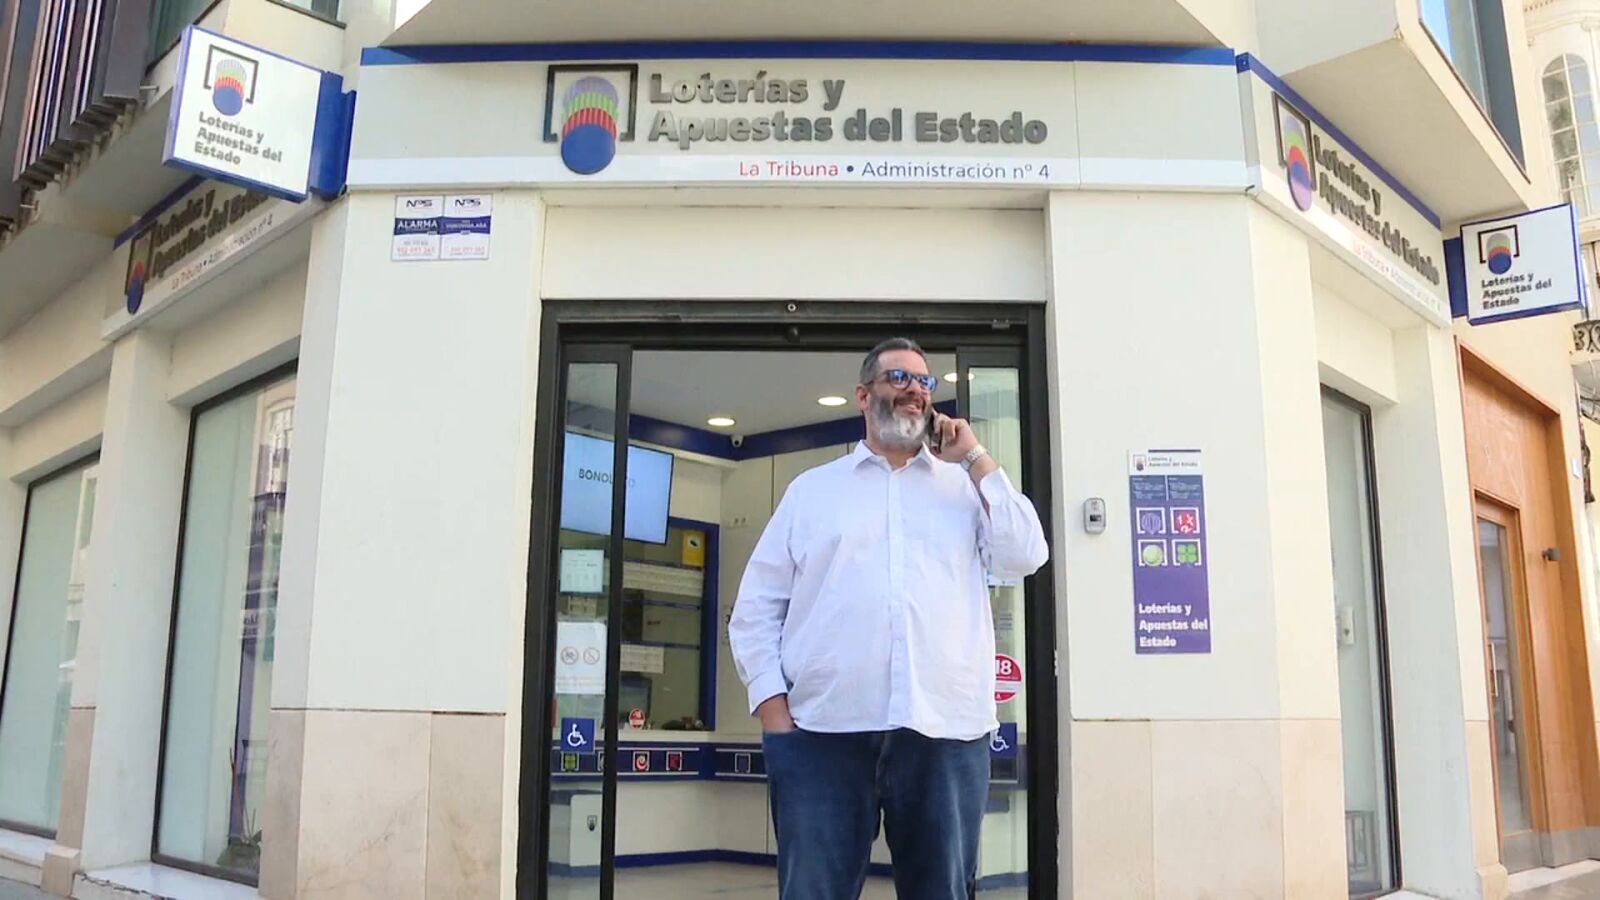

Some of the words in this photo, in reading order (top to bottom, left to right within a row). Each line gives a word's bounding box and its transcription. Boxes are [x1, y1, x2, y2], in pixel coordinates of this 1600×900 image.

[650, 70, 810, 104] Loterías
[822, 79, 845, 111] y
[256, 131, 265, 144] y
[648, 110, 833, 151] Apuestas
[843, 107, 902, 142] del
[915, 110, 1048, 145] Estado
[194, 140, 241, 165] Estado
[197, 127, 260, 156] Apuestas
[262, 147, 283, 163] del
[739, 161, 760, 177] La
[767, 160, 839, 177] Tribuna
[861, 161, 1006, 179] Administración
[1038, 164, 1049, 179] 4
[397, 219, 438, 229] ALARMA
[1319, 172, 1382, 241] Apuestas
[1401, 237, 1440, 286] Estado
[1527, 272, 1534, 282] y
[1483, 284, 1532, 299] Apuestas
[1535, 278, 1552, 290] del
[1483, 297, 1520, 310] Estado
[1184, 603, 1192, 616] y
[1139, 619, 1188, 633] Apuestas
[1191, 618, 1209, 631] del
[1140, 635, 1177, 647] Estado
